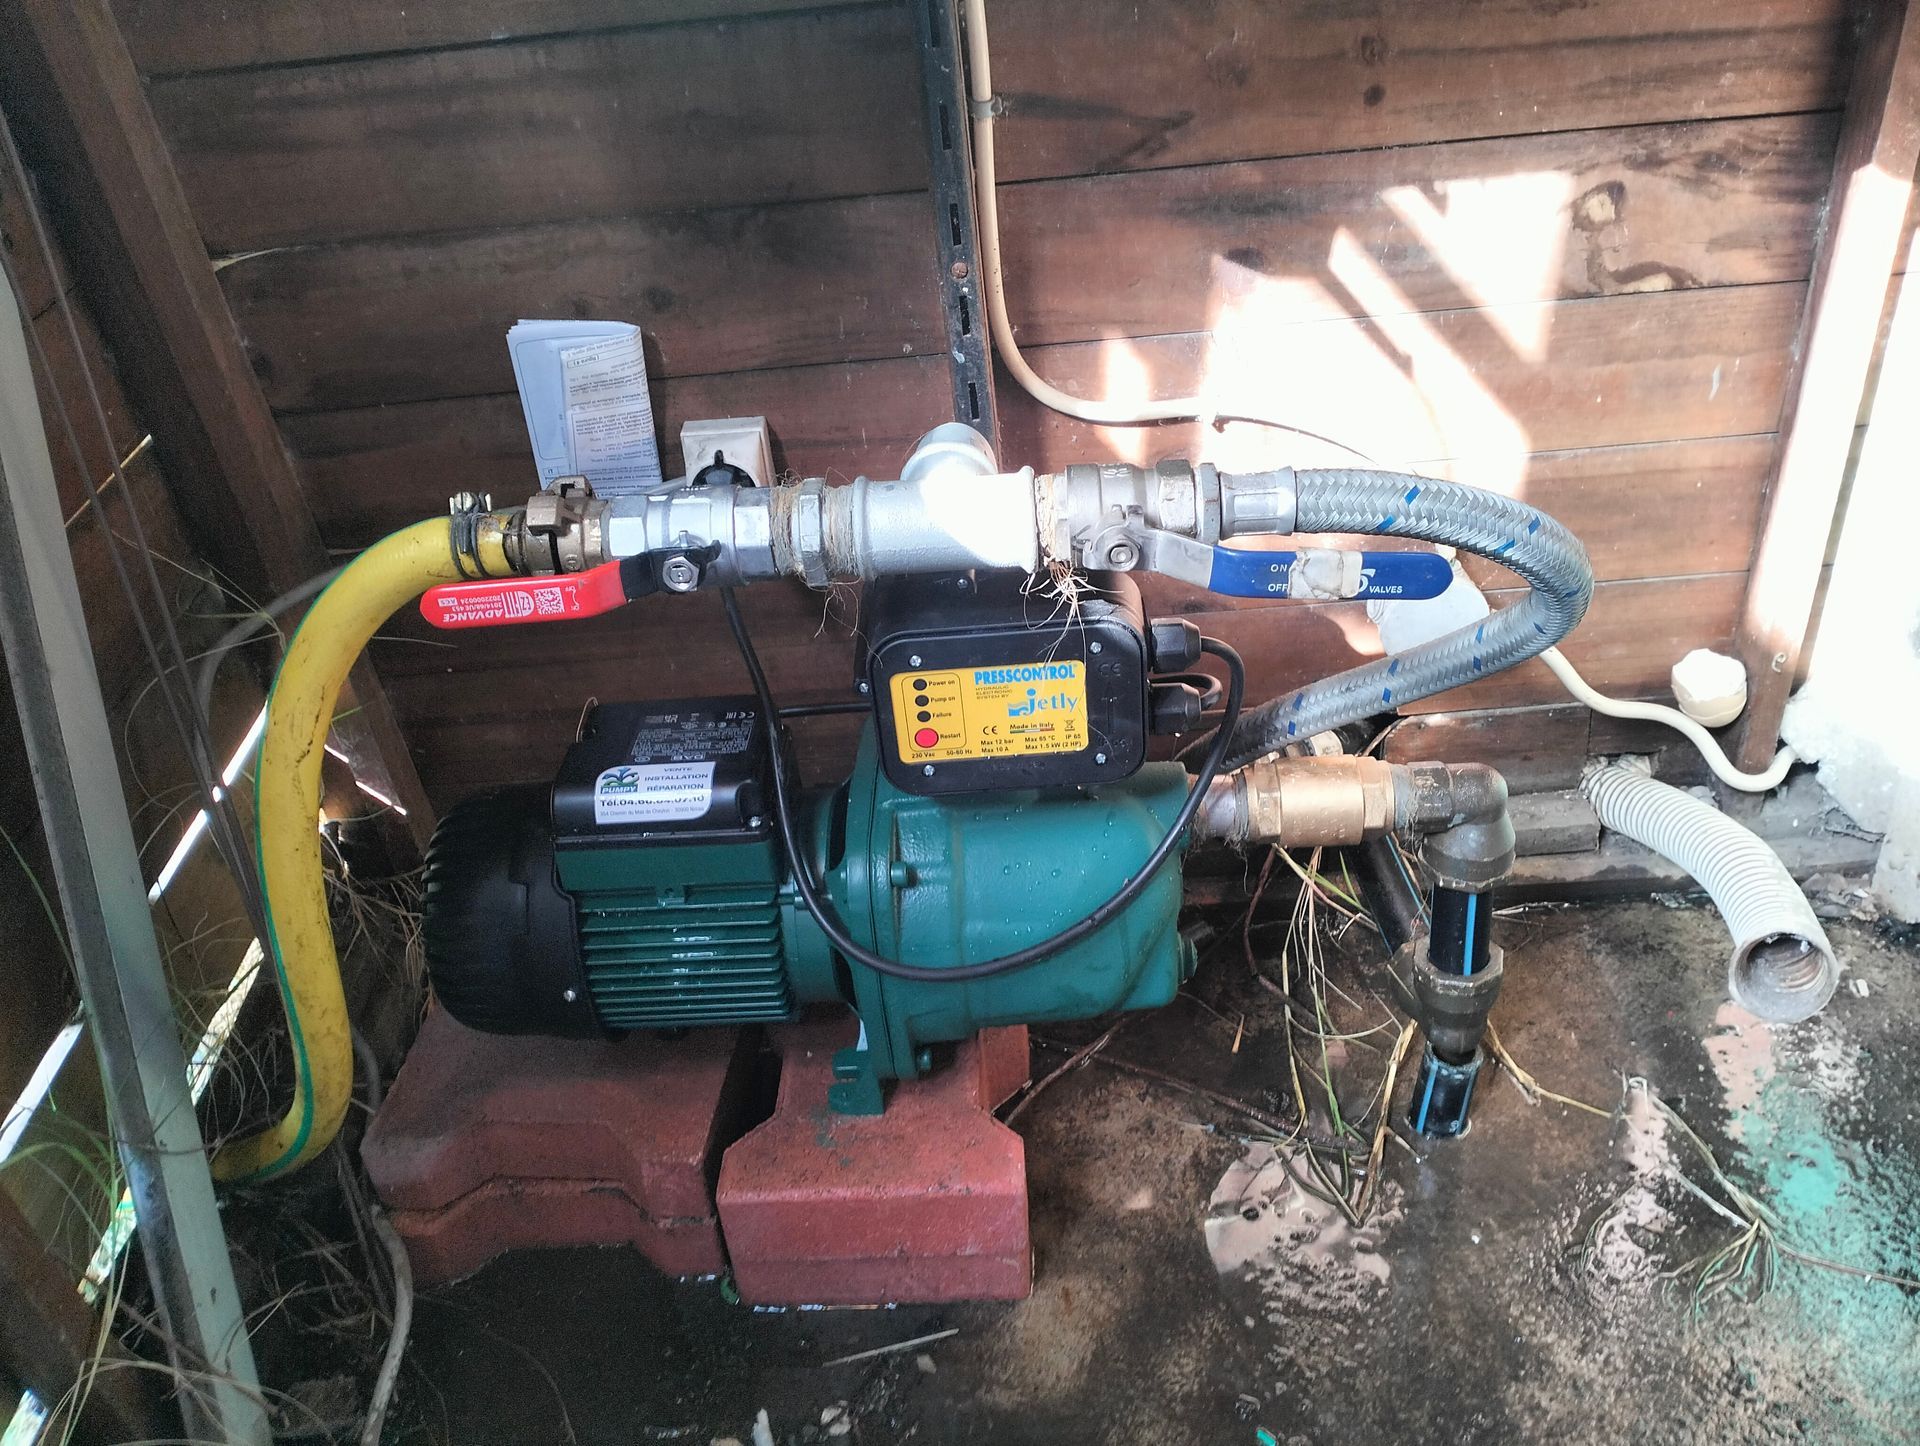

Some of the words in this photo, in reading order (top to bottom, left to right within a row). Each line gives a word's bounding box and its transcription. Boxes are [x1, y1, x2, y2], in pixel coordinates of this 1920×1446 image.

[1270, 564, 1287, 572] ON
[1268, 583, 1288, 592] OFF
[1369, 585, 1403, 593] VALVES
[443, 609, 503, 622] ADVANCE
[974, 664, 1075, 685] PRESSCONTROL
[645, 773, 708, 781] INSTALLATION
[647, 783, 704, 792] RÉPARATION
